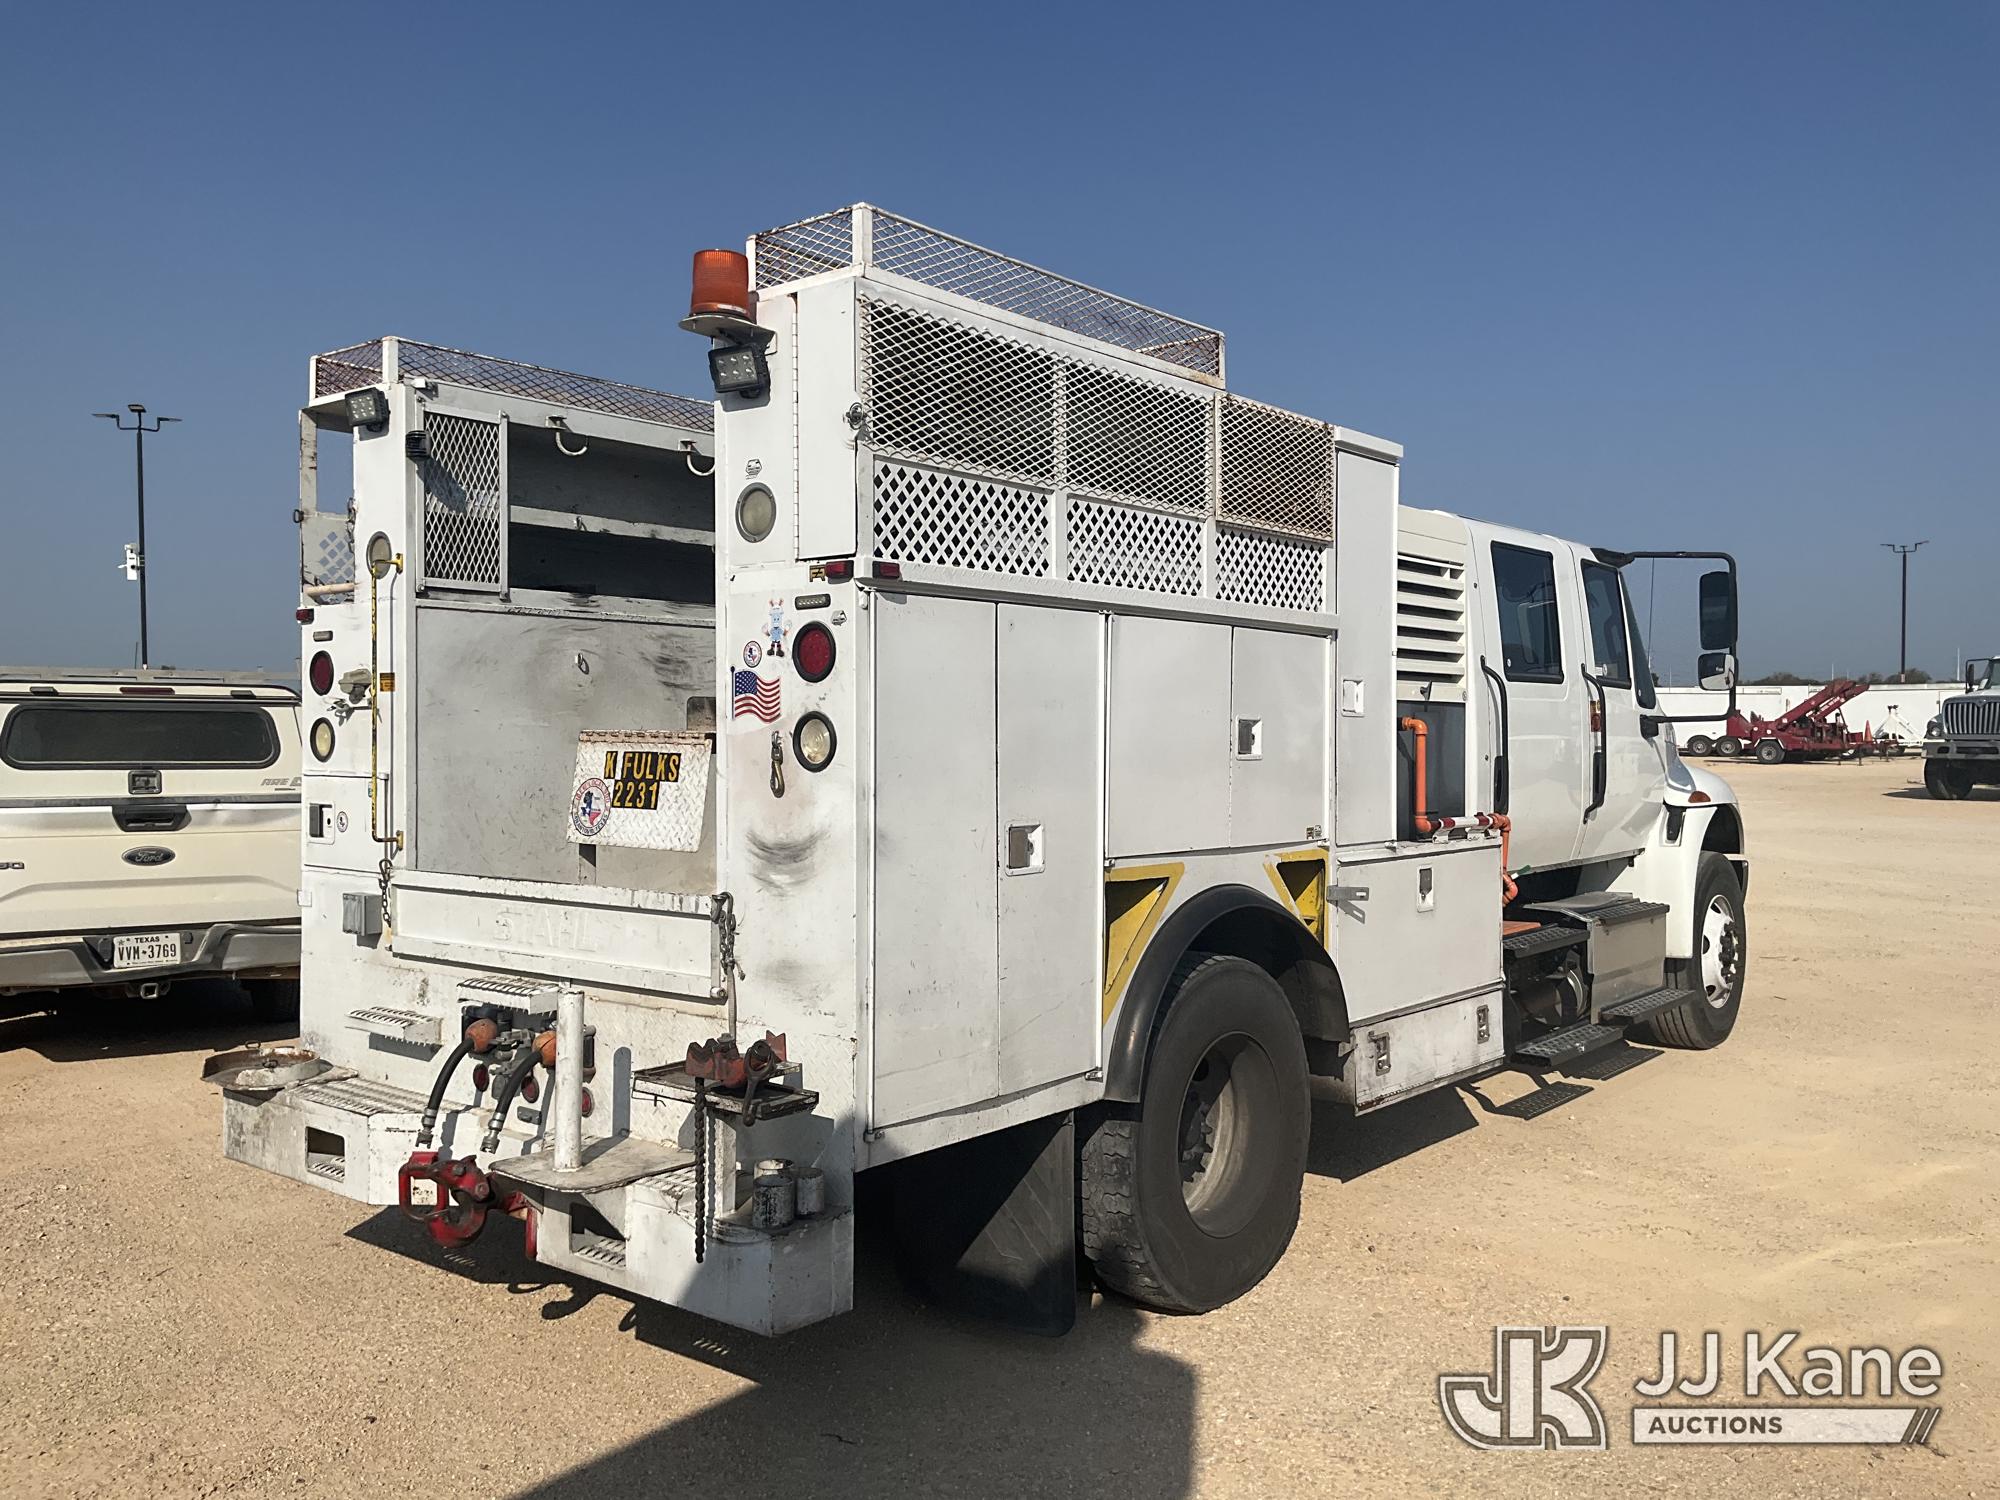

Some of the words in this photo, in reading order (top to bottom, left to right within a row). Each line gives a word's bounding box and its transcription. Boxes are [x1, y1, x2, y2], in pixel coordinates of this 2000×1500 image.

[604, 752, 617, 779] K
[622, 752, 680, 782] FULKS
[612, 781, 658, 809] 2231
[135, 850, 164, 862] Ford
[134, 936, 160, 944] TEXAS
